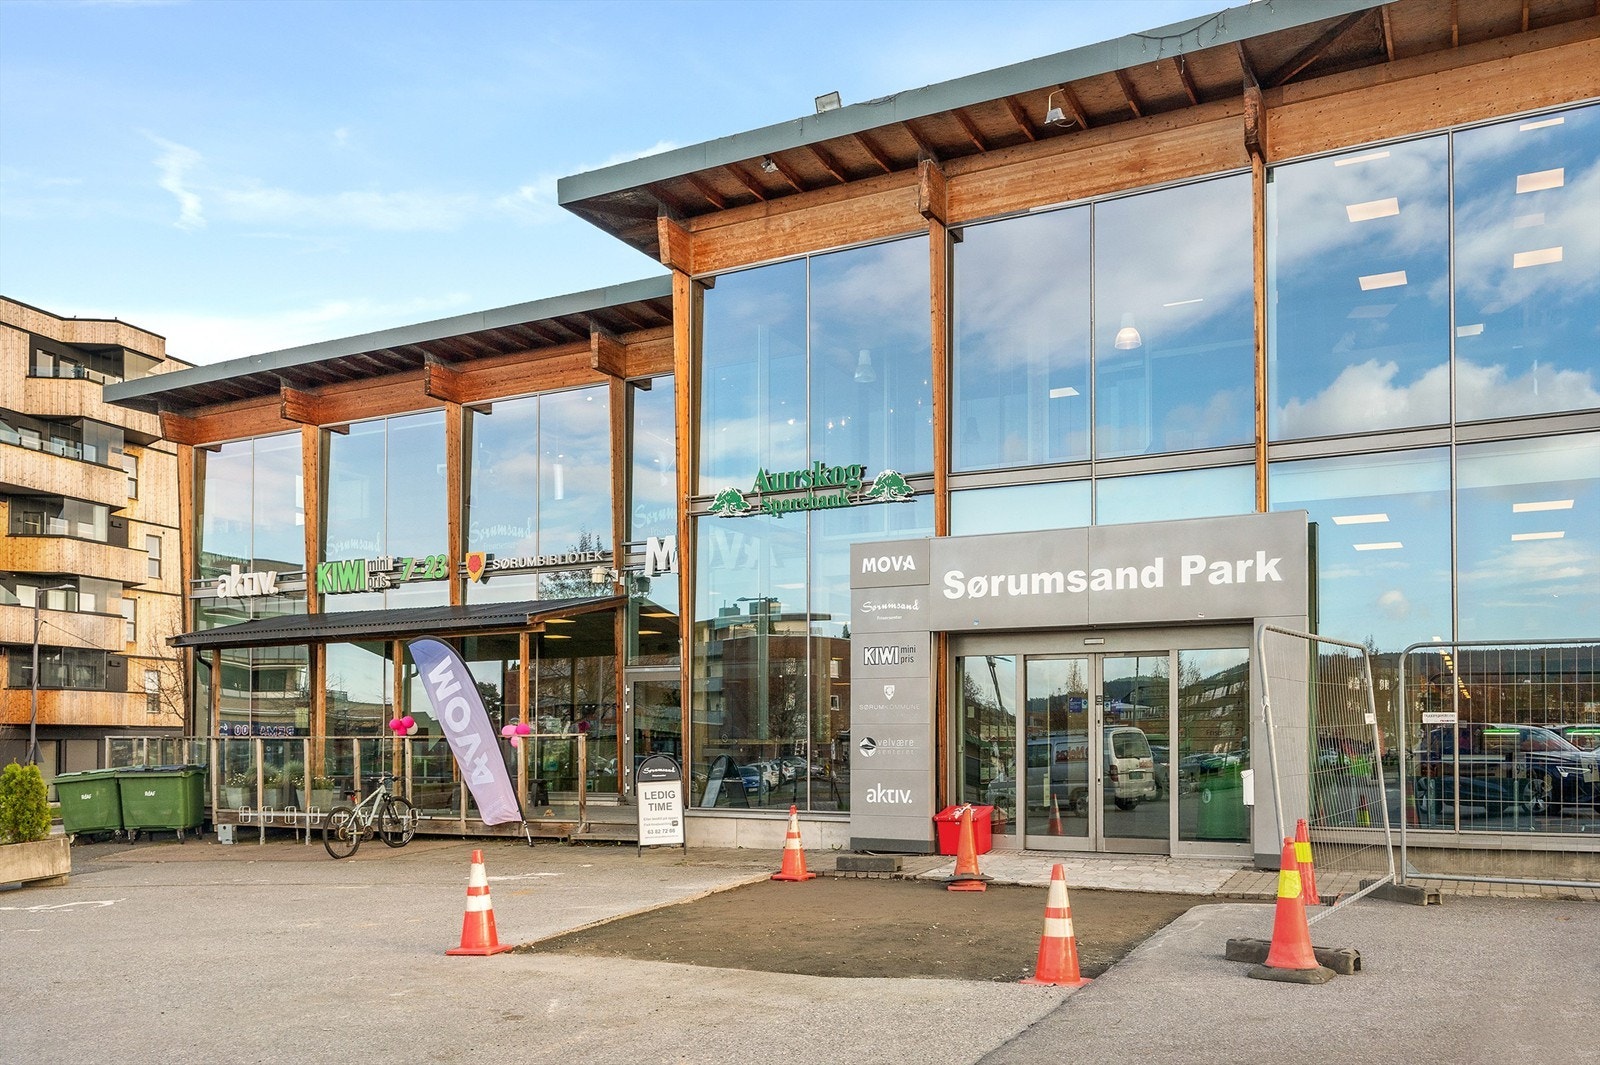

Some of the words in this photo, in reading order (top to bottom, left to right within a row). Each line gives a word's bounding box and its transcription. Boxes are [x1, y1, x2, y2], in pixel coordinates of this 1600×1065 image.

[751, 460, 863, 493] Aurskog
[762, 490, 850, 517] Sparebank
[492, 550, 604, 570] SØRUMBIBLIOTEK
[862, 555, 916, 574] MOVA
[317, 558, 367, 594] KIWI
[367, 555, 391, 572] mini
[943, 557, 1164, 600] Sørumsand
[1181, 550, 1282, 587] Park
[864, 646, 900, 666] KIWI
[901, 645, 916, 654] mini
[901, 655, 914, 665] pris
[428, 655, 495, 786] MOVA
[644, 790, 676, 800] LEDIG
[648, 802, 673, 812] TIME
